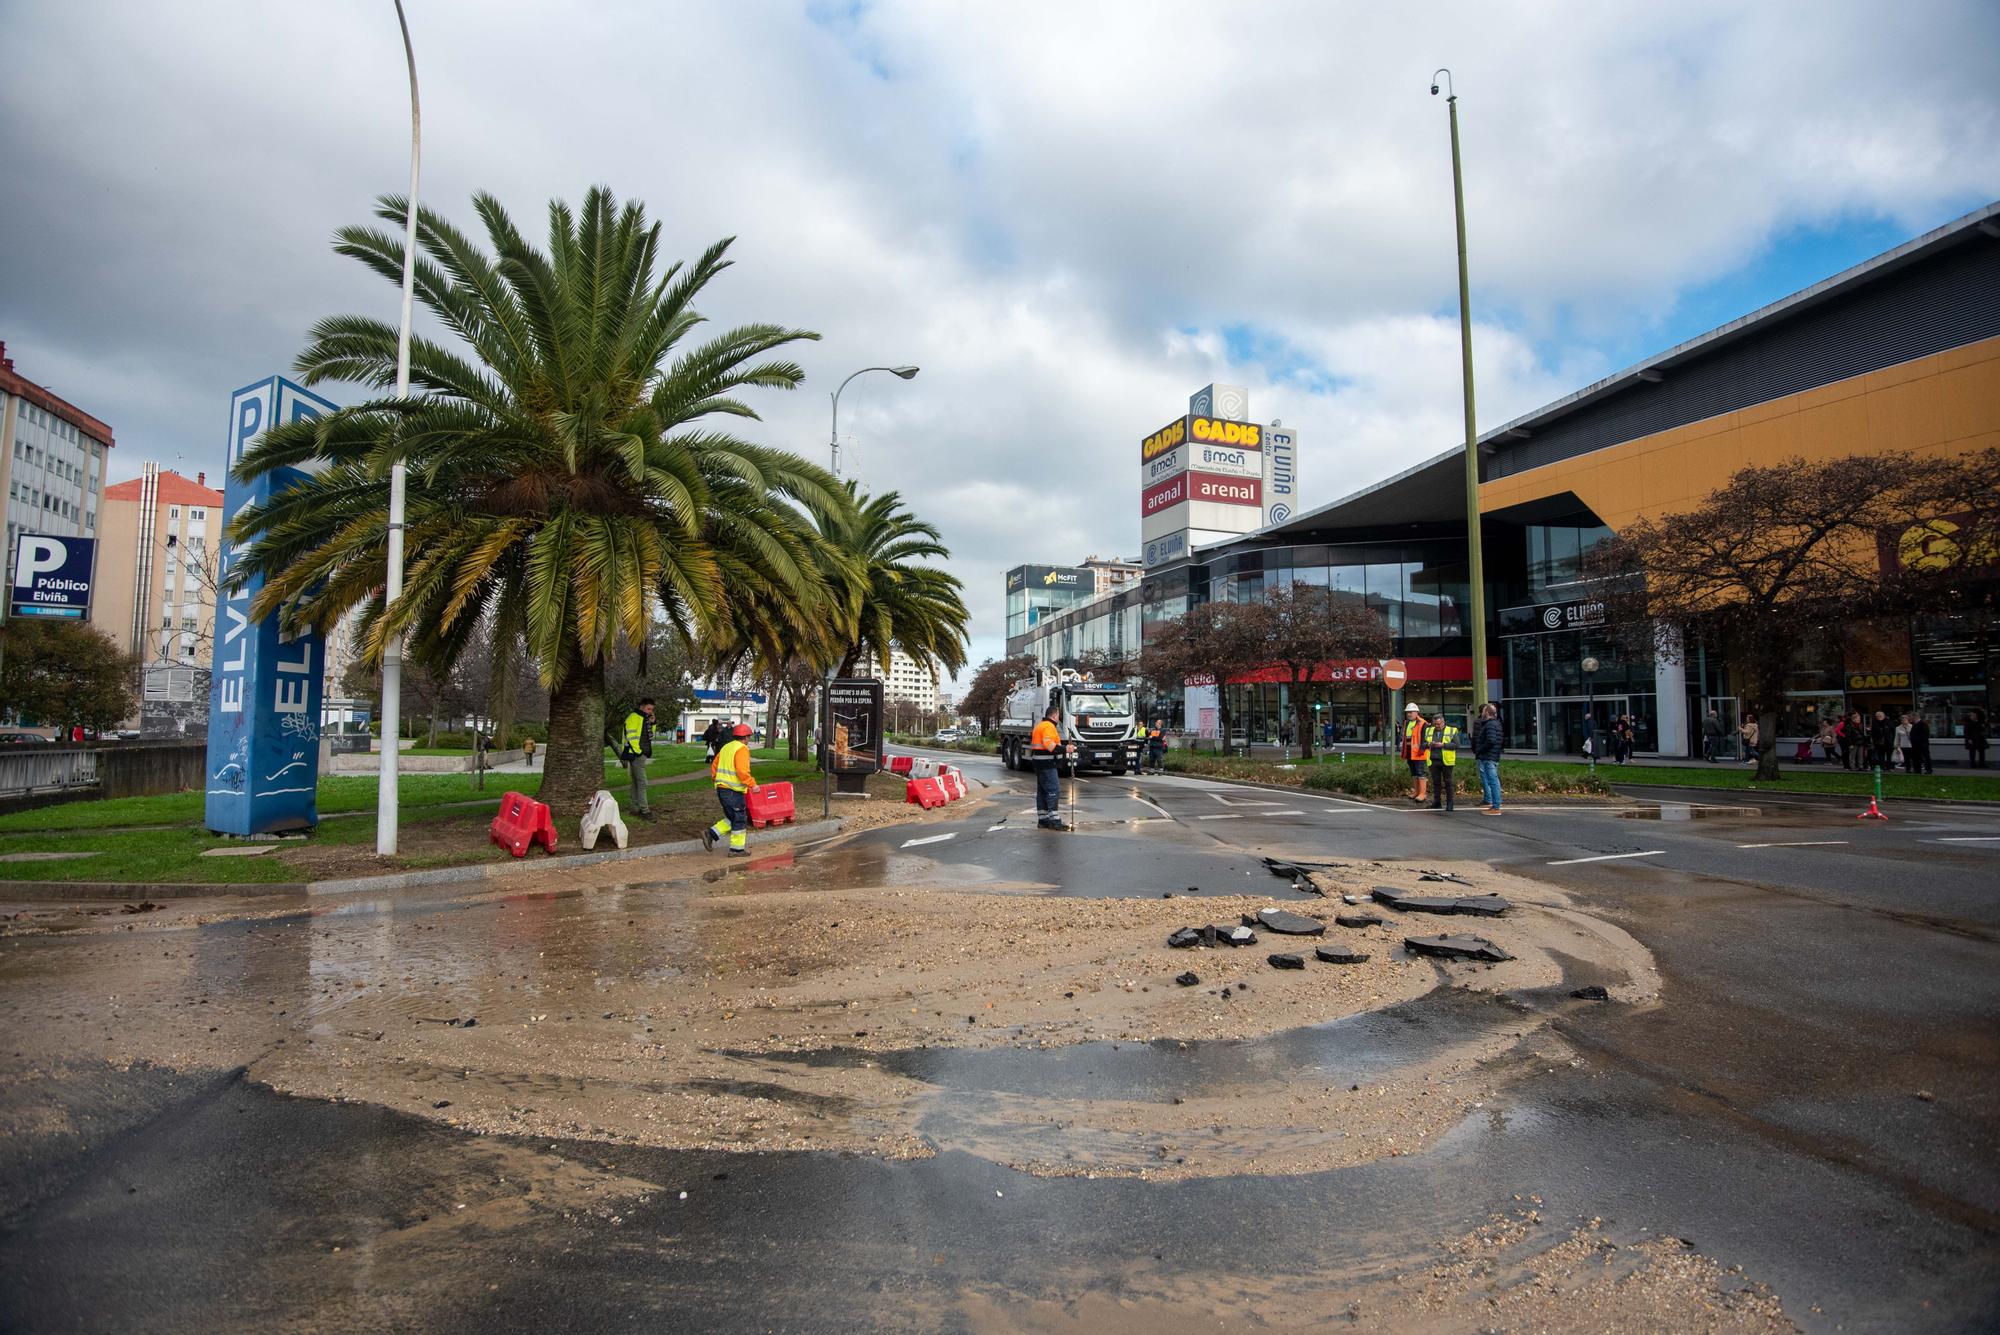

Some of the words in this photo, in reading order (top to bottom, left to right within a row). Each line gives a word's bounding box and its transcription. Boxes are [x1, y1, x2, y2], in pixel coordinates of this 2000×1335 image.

[1144, 420, 1184, 459] GADIS
[1192, 418, 1260, 447] GADIS
[1148, 481, 1180, 509] arenal
[1201, 483, 1254, 499] arenal
[15, 535, 67, 588] P
[38, 578, 89, 591] Público
[33, 591, 69, 602] Elviña
[1331, 666, 1383, 679] aren
[1850, 674, 1909, 689] GADIS
